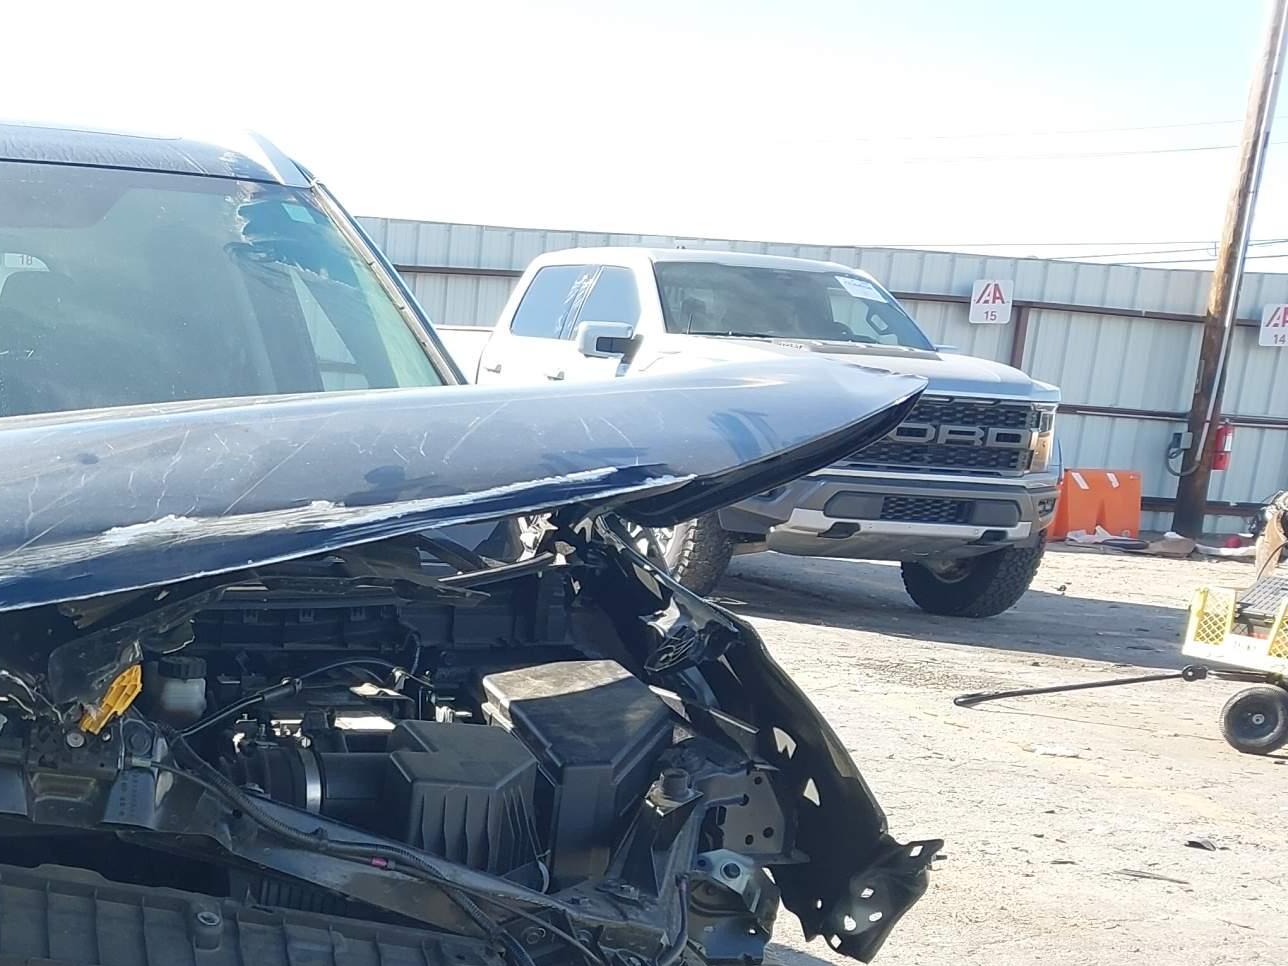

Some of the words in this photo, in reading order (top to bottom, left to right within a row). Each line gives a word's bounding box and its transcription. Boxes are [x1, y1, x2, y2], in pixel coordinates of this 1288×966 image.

[983, 310, 998, 321] 15
[1273, 333, 1287, 345] 14
[887, 422, 1032, 449] ORD
